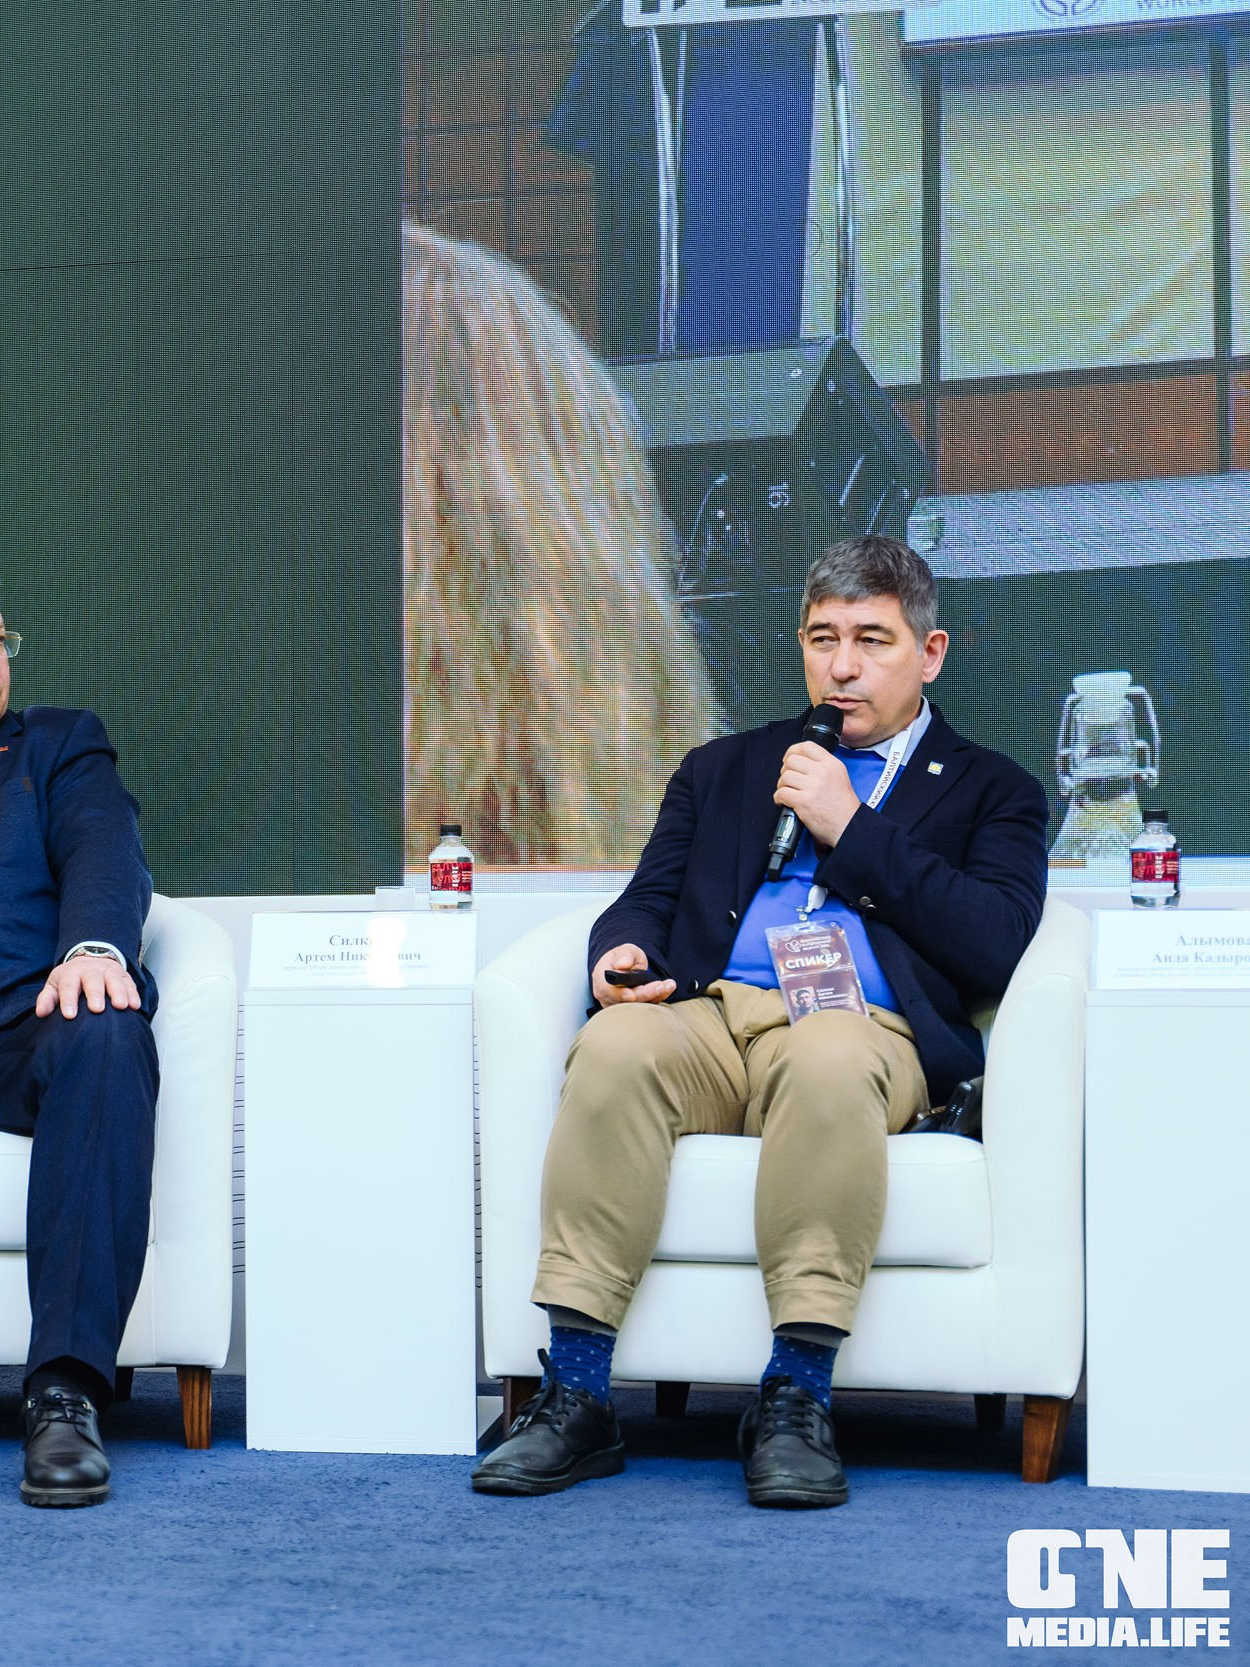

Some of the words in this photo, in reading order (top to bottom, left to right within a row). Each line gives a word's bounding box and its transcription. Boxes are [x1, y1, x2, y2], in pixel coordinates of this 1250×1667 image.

[768, 481, 791, 509] 16
[329, 934, 373, 946] Силк
[295, 952, 335, 964] Артем
[785, 952, 842, 970] СПИКЕР
[1153, 953, 1189, 963] Аида
